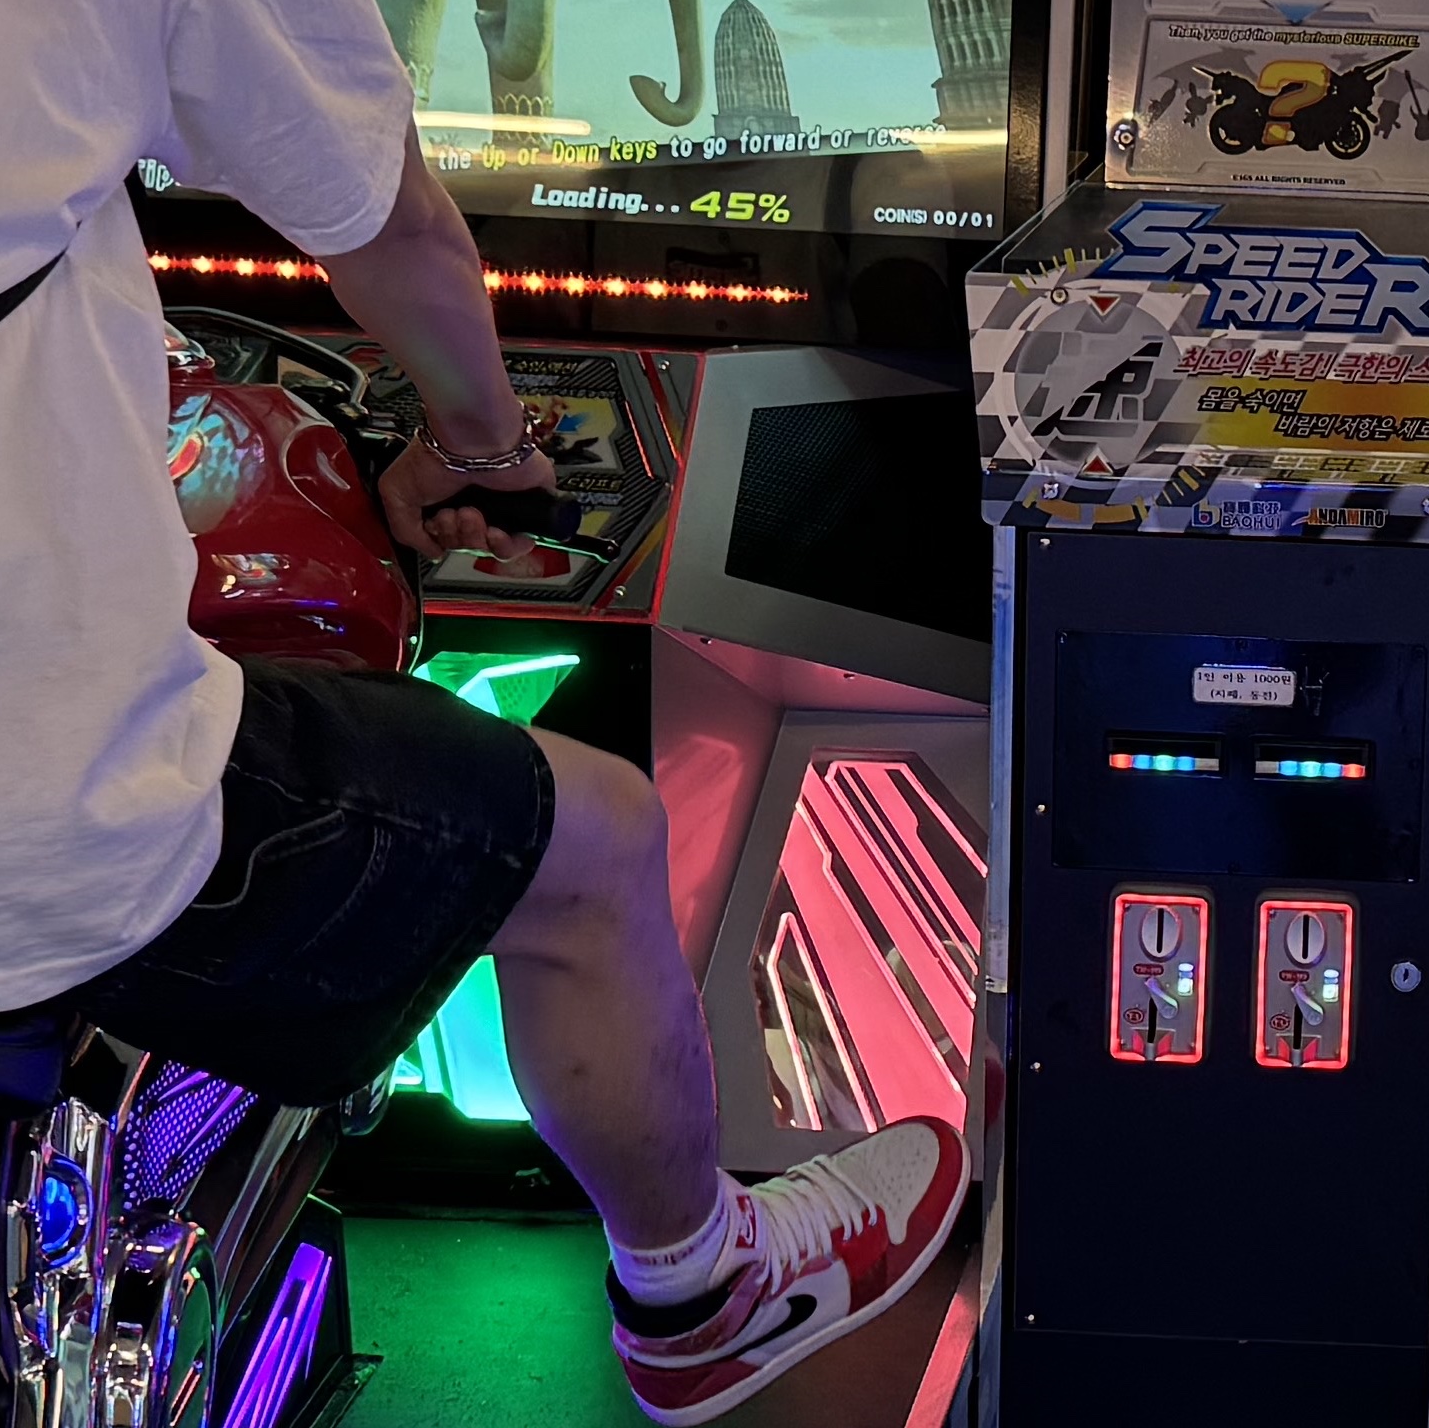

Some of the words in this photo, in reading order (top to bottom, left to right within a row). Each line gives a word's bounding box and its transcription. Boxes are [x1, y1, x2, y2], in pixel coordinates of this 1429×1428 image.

[1203, 27, 1228, 42] you
[1230, 28, 1252, 42] get
[1253, 29, 1273, 41] the
[1275, 32, 1341, 45] mysterious
[439, 149, 471, 171] the
[483, 145, 506, 171] Up
[518, 149, 539, 167] or
[552, 141, 600, 165] Down
[610, 135, 657, 162] keys
[670, 136, 693, 159] to
[703, 138, 727, 160] go
[740, 127, 821, 154] forward
[830, 130, 852, 149] or
[532, 183, 681, 213] Loading...
[690, 189, 790, 224] 45%
[873, 206, 928, 224] COIN(S)
[932, 210, 994, 228] 00/01
[1108, 209, 1371, 279] SPEED
[1176, 346, 1254, 377] 최고의
[1254, 349, 1337, 380] 속도감!
[1338, 353, 1412, 382] 극한의
[1201, 389, 1241, 410] 몸을
[1244, 390, 1304, 413] 숙이면
[1276, 414, 1336, 437] 바람의
[1339, 417, 1393, 440] 저항은
